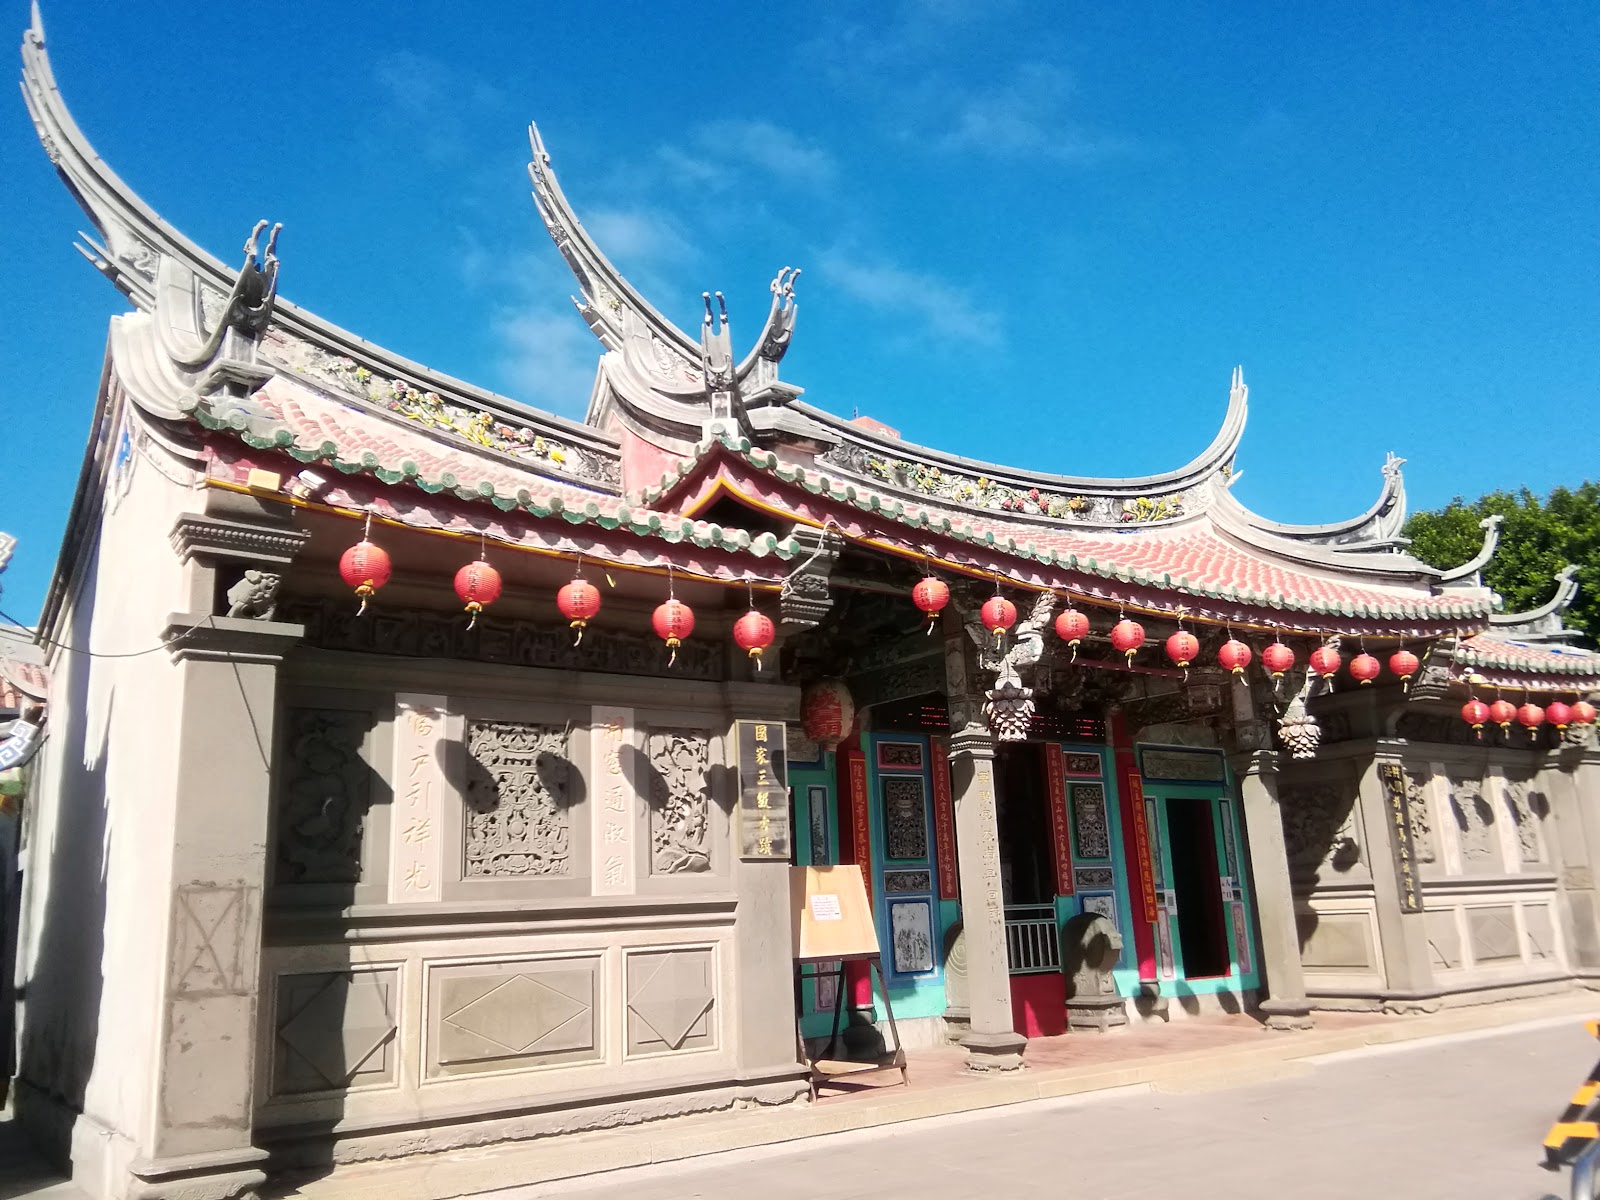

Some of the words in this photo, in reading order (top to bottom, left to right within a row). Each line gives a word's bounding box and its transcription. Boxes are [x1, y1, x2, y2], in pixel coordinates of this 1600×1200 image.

[754, 724, 773, 856] 國家三級古蹟
